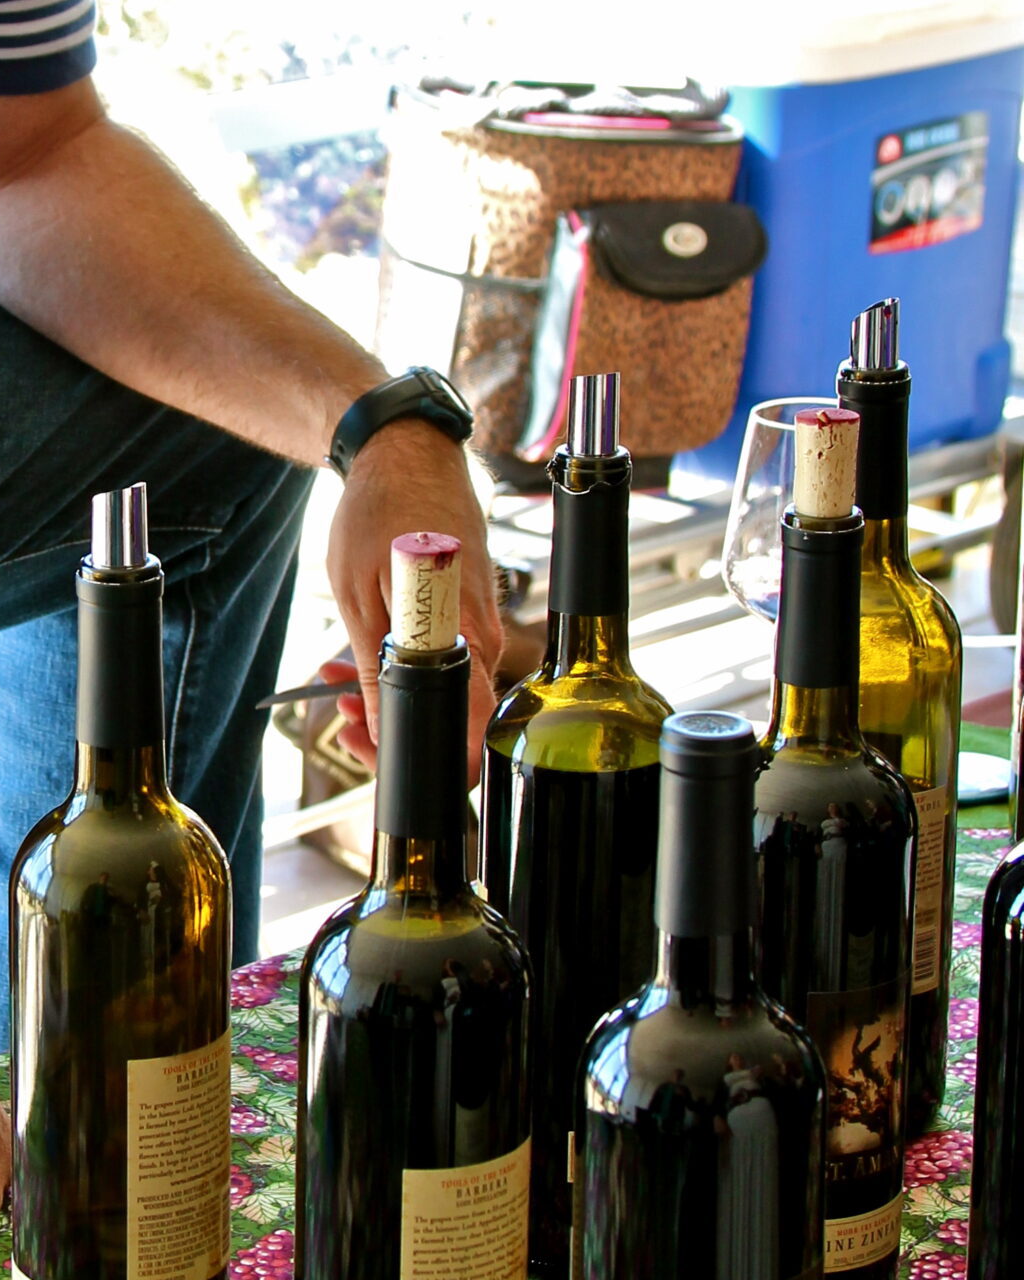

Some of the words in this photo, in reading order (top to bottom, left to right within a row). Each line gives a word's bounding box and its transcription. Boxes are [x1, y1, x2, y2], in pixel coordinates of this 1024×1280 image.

[411, 568, 432, 647] AMANT
[163, 1063, 186, 1075] TOOLS
[177, 1060, 218, 1083] BARBERA
[160, 1149, 173, 1157] with
[441, 1180, 467, 1189] TOOLS
[470, 1176, 479, 1185] OF
[484, 1172, 496, 1181] THE
[456, 1177, 507, 1199] BARBERA
[137, 1194, 169, 1203] PRODUCED
[171, 1190, 182, 1199] AND
[826, 1237, 854, 1252] INE
